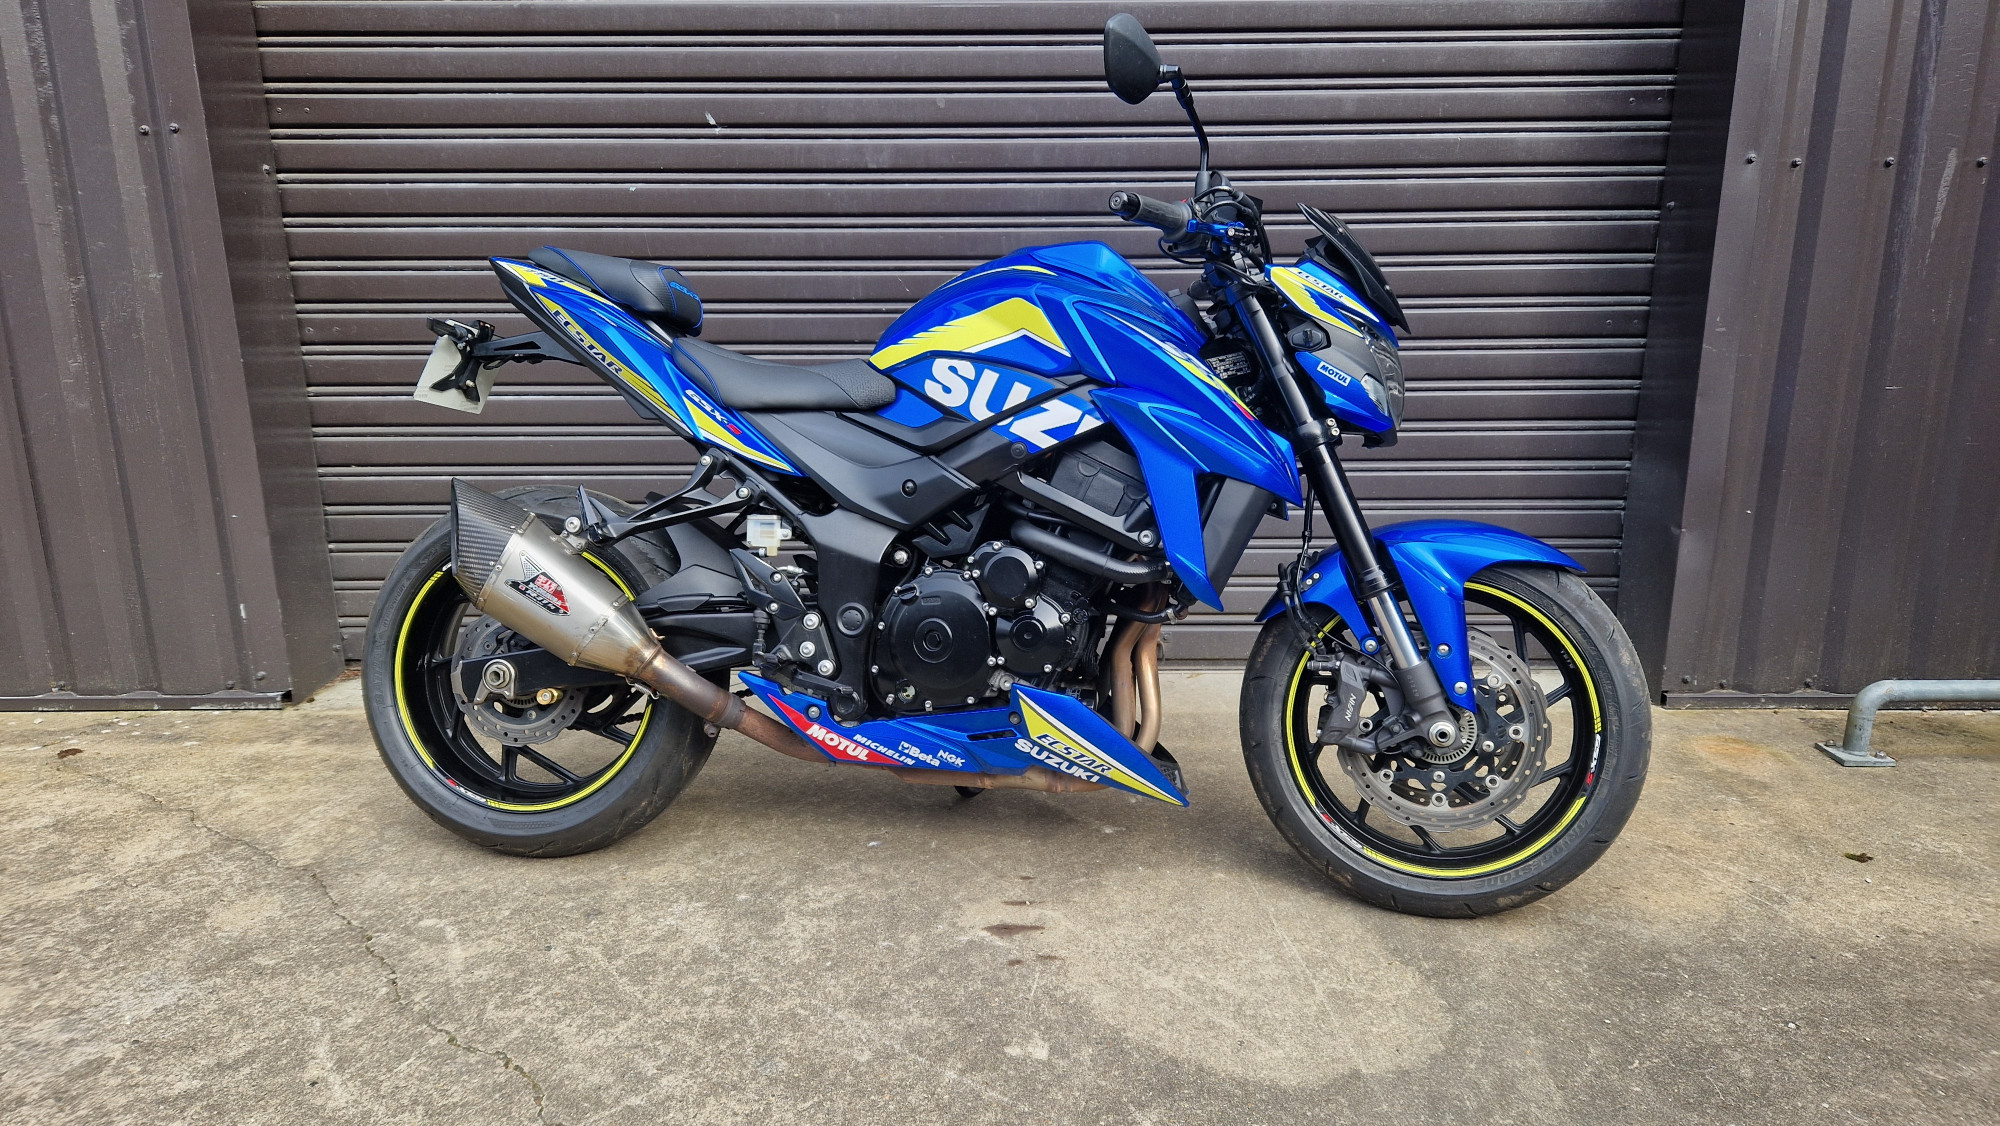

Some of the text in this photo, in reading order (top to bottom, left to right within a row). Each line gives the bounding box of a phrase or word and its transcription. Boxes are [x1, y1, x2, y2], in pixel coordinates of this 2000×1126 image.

[552, 309, 624, 376] ECSTAR
[1319, 364, 1349, 385] MOTUL
[924, 358, 1104, 449] SUZ
[805, 724, 869, 761] MOTUL
[852, 734, 916, 766] MICHELIN
[905, 745, 941, 767] Beta
[937, 749, 966, 767] NGK
[1014, 738, 1101, 783] SUZUKI
[1034, 733, 1113, 774] ECSTAR
